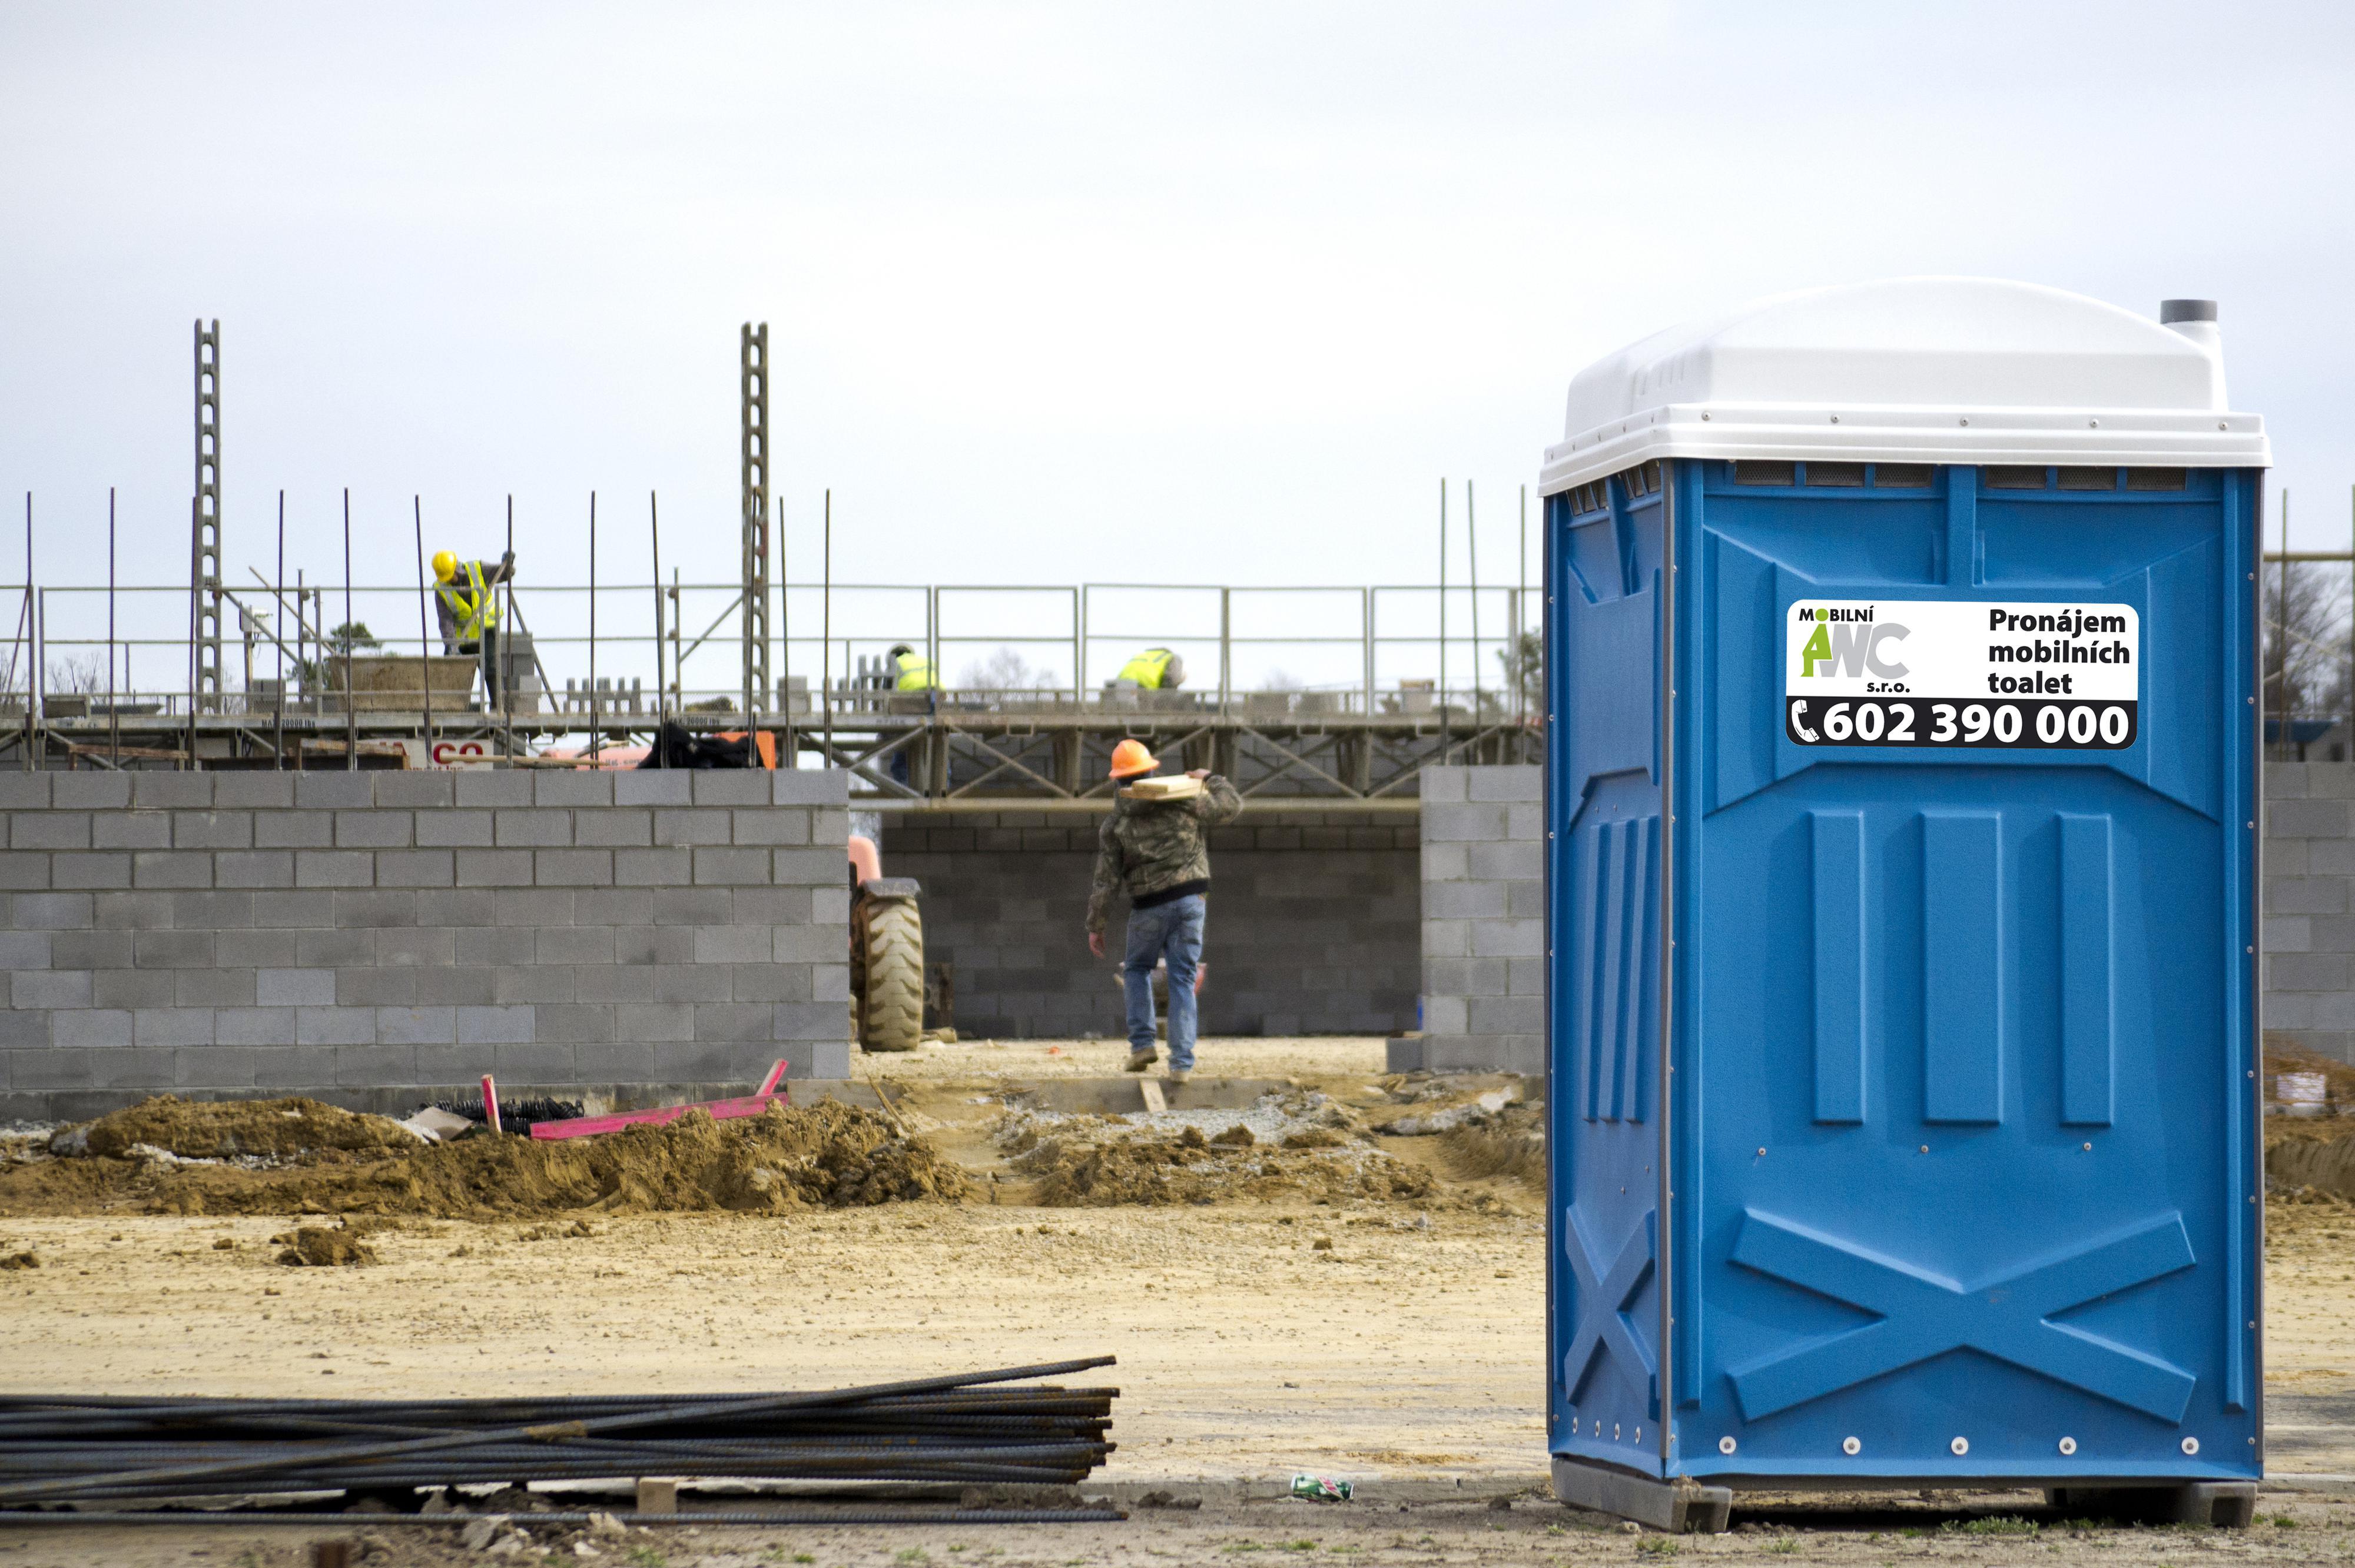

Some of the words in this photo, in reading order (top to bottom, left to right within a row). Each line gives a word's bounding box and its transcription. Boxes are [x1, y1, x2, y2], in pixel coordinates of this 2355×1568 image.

[1799, 605, 1874, 622] MOBILNÍ
[1989, 609, 2125, 639] Pronájem
[1989, 639, 2130, 664] mobilních
[1866, 682, 1910, 693] s.r.o.
[1988, 670, 2072, 694] toalet
[1823, 702, 1916, 742] 602
[1930, 703, 2023, 743] 390
[2035, 705, 2129, 745] 000
